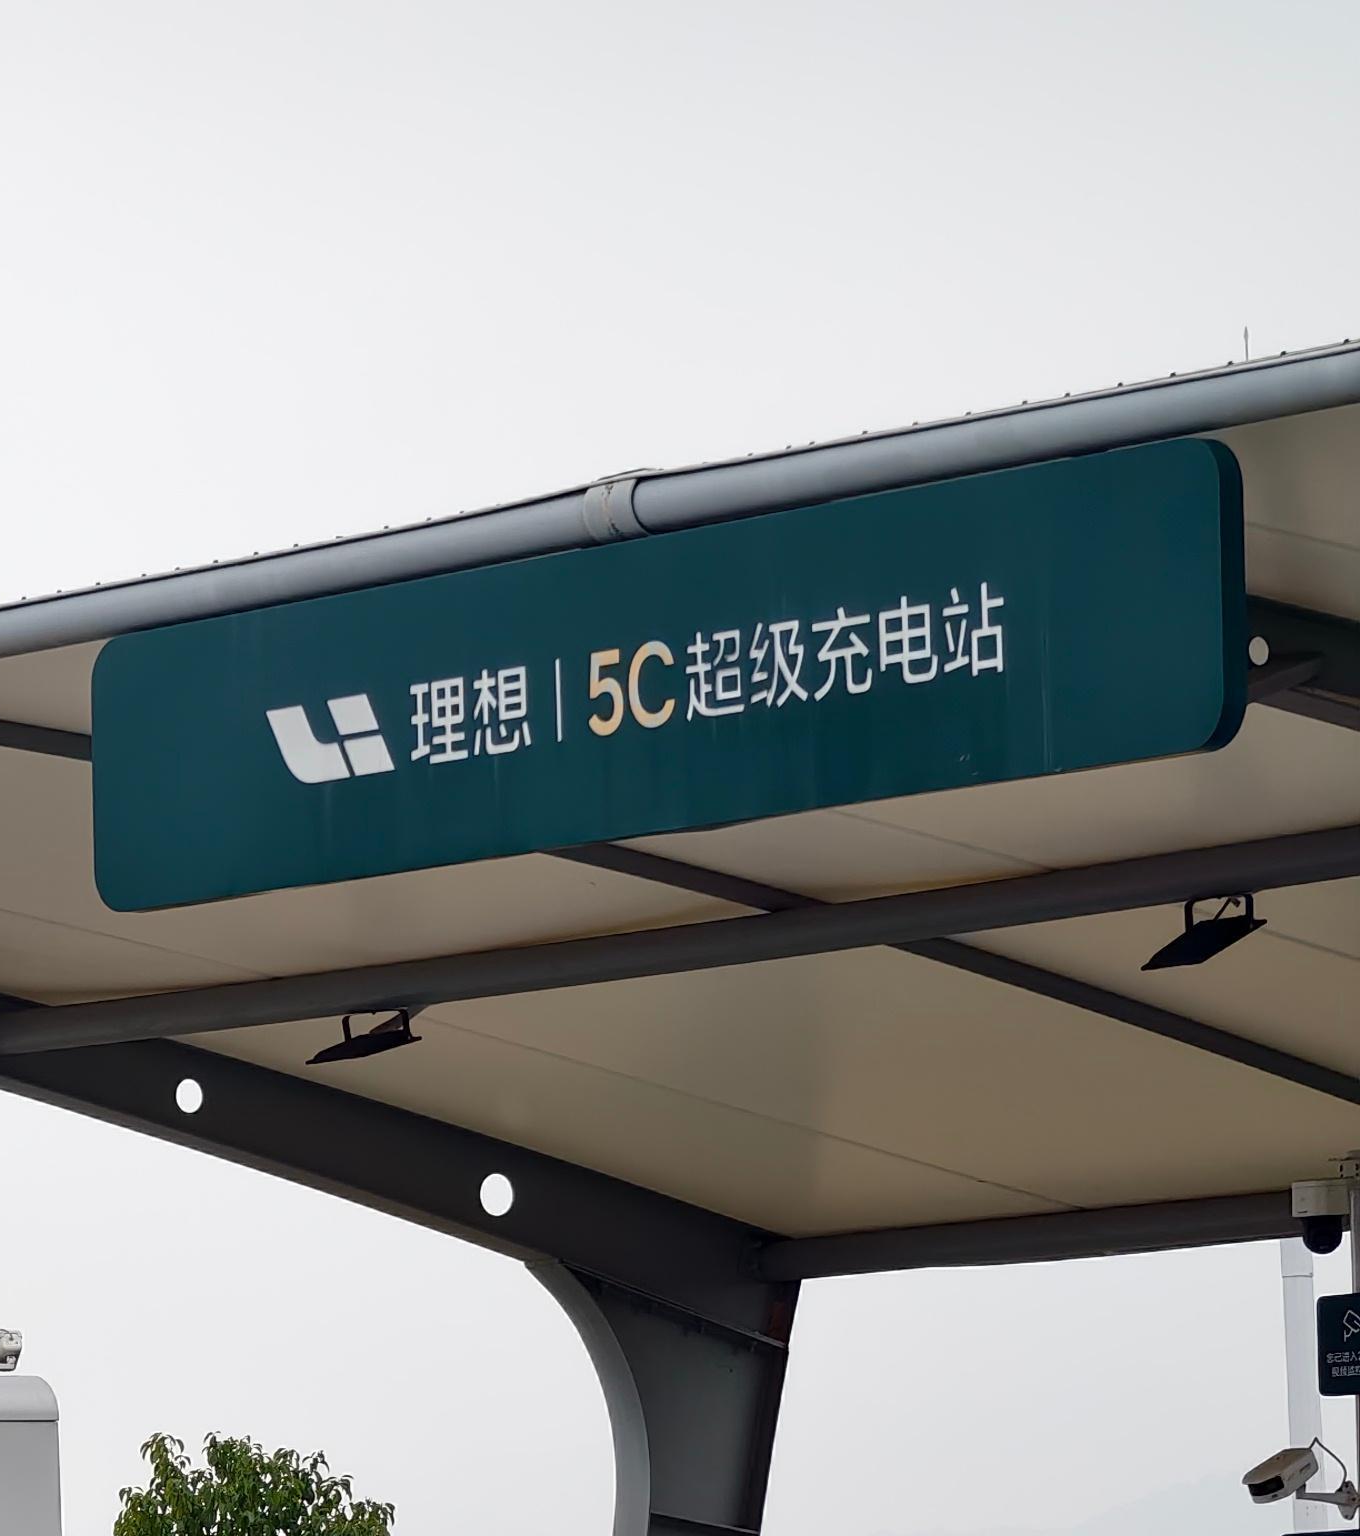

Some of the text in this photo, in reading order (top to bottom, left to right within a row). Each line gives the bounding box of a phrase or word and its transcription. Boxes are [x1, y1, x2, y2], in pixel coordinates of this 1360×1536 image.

[409, 581, 1006, 766] 理想 5C超级充电站
